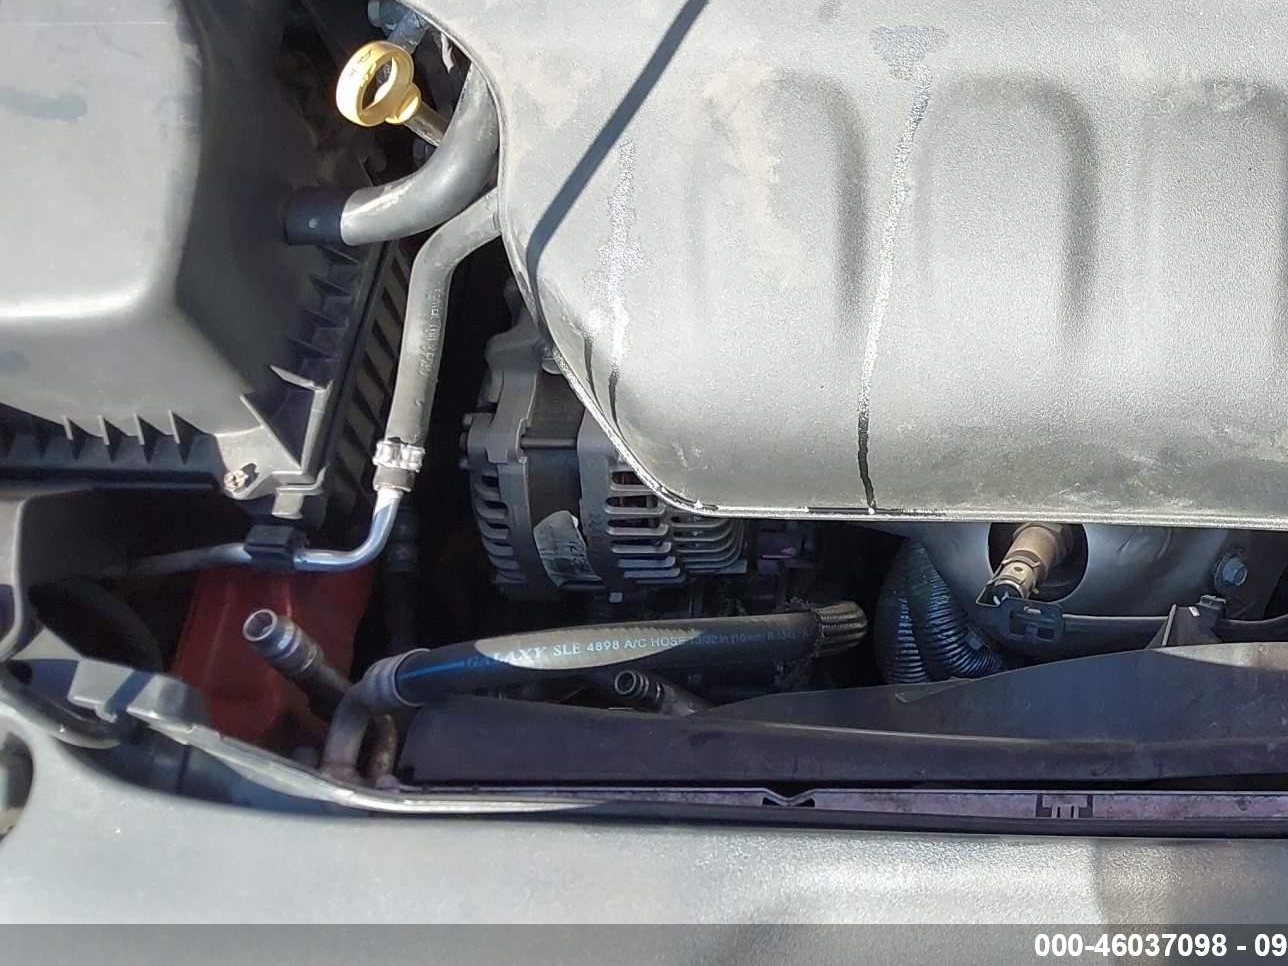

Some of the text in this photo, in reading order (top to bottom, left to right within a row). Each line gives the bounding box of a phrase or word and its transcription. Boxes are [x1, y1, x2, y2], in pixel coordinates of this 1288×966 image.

[466, 645, 548, 667] GALAXY
[552, 642, 581, 657] SLE
[586, 640, 620, 652] 4898
[623, 638, 647, 650] A/C
[650, 635, 688, 647] HOSE
